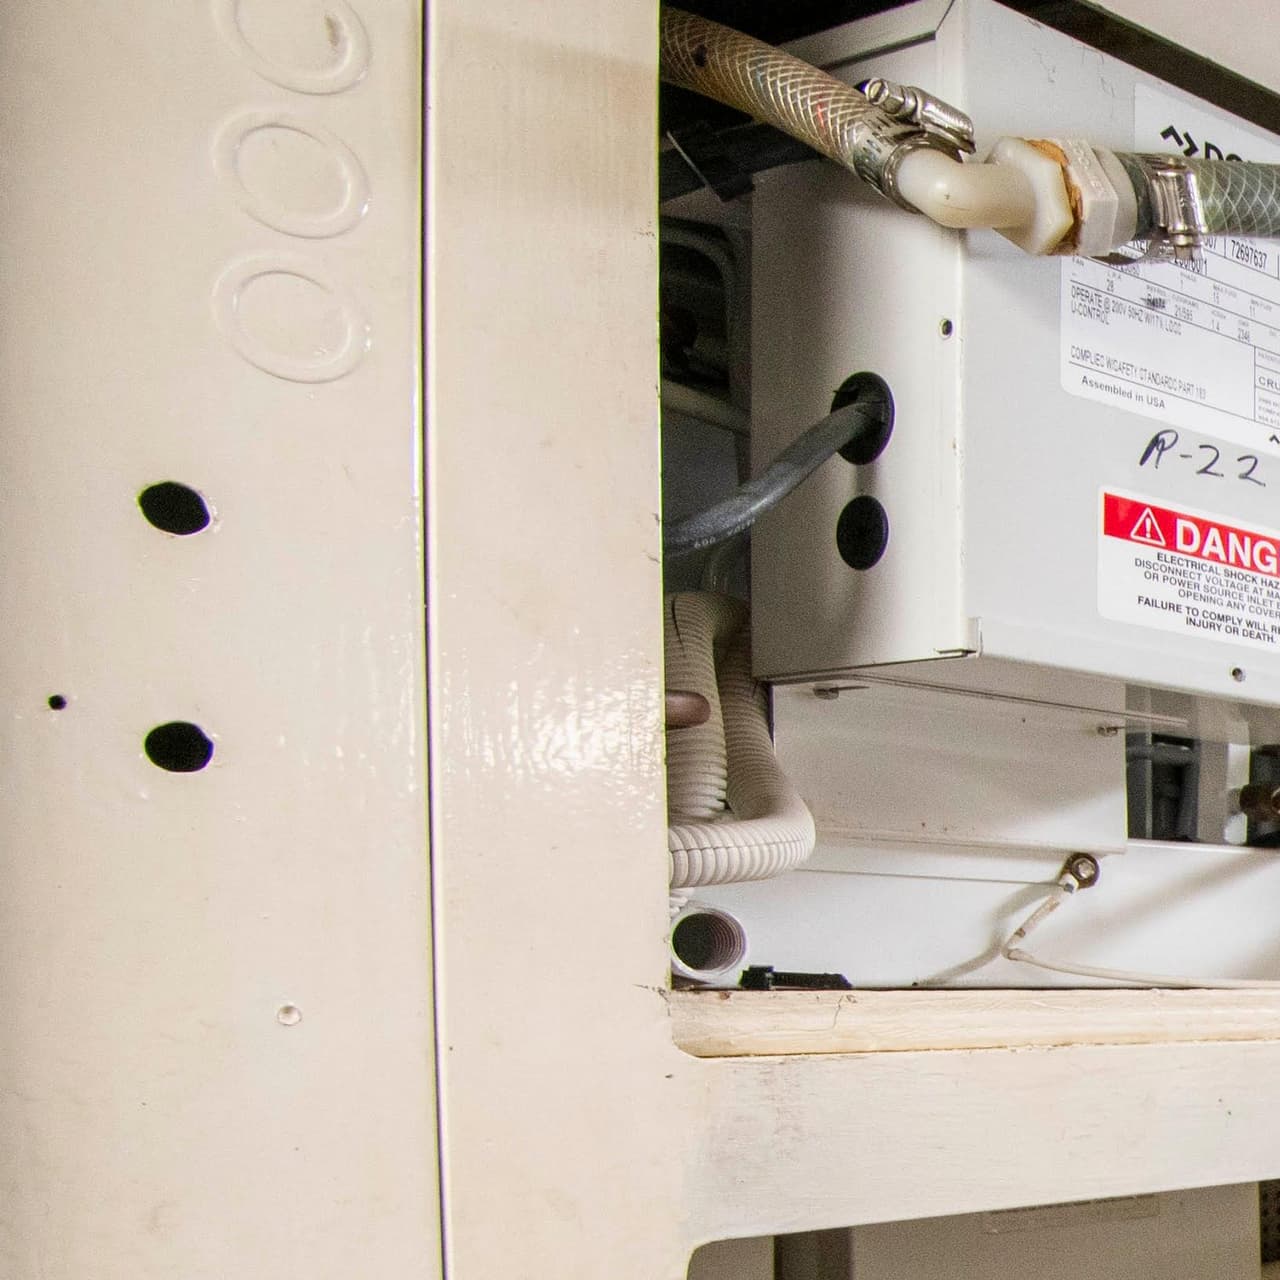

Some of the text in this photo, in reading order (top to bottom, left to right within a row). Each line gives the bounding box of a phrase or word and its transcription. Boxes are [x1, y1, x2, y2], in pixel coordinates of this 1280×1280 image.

[1231, 239, 1268, 269] 72697637
[1081, 375, 1166, 409] Assembled in USA
[1134, 557, 1203, 583] DISCONNECT
[1205, 574, 1250, 593] VOLTAGE
[1252, 586, 1264, 596] AT
[1156, 551, 1222, 577] ELECTRICAL
[1223, 567, 1258, 585] SHOCK
[1144, 571, 1160, 583] OR
[1162, 574, 1201, 592] POWER
[1203, 584, 1245, 602] SOURCE
[1246, 593, 1274, 608] INLET
[1178, 588, 1224, 608] OPENING
[1225, 599, 1246, 612] ANY
[1137, 595, 1183, 614] FAILURE
[1185, 606, 1200, 617] TO
[1202, 609, 1243, 626] COMPLY
[1245, 620, 1269, 633] WILL
[1185, 616, 1222, 633] INJURY
[1224, 625, 1239, 637] OR
